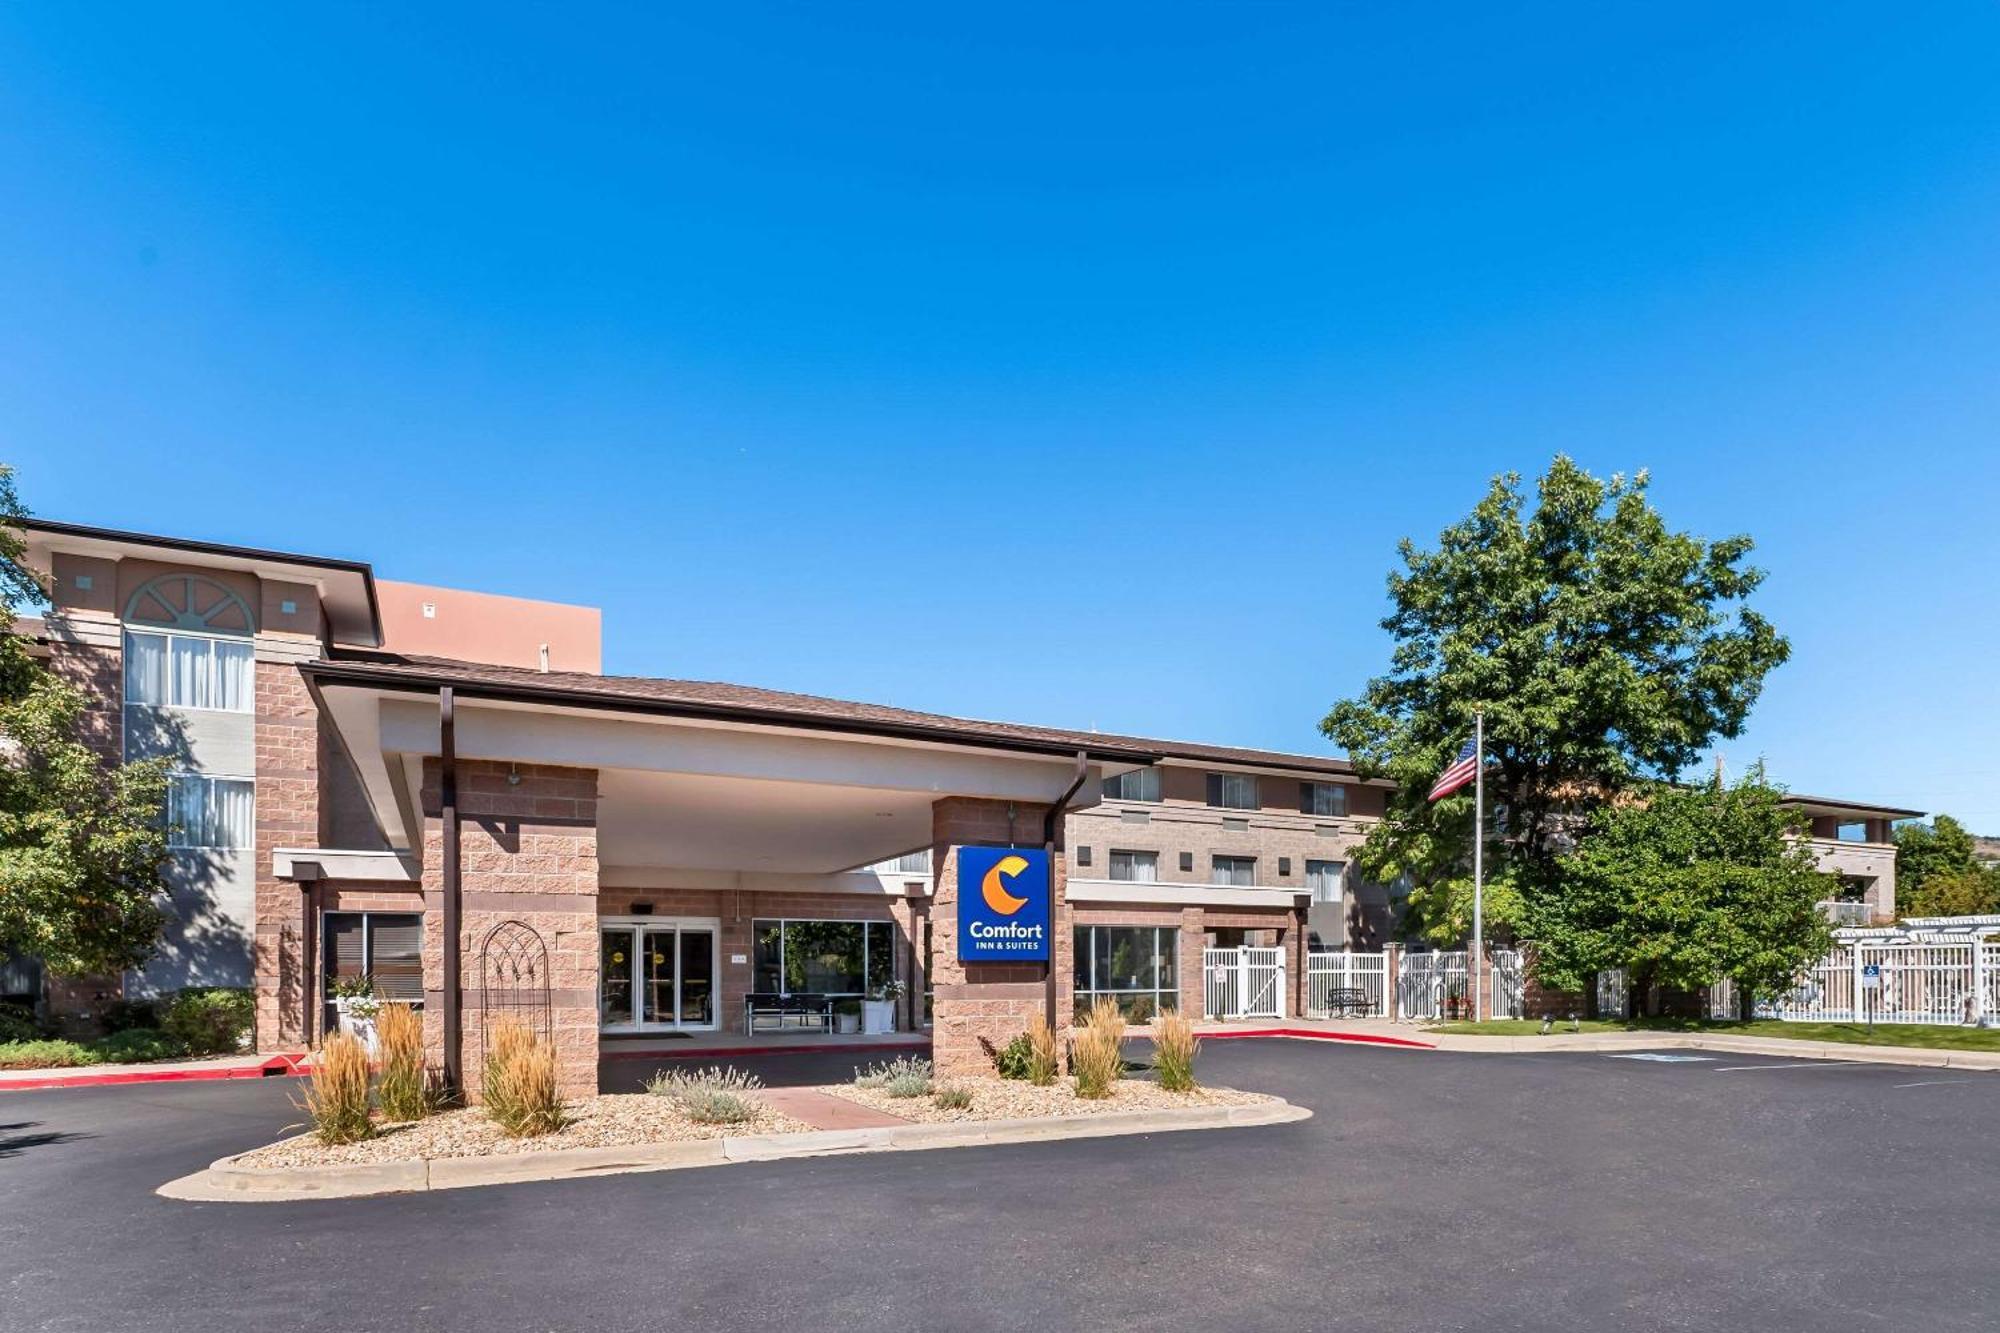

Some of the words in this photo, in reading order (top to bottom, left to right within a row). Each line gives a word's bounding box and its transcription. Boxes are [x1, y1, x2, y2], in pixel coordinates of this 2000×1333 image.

[970, 921, 1042, 938] Comfort
[976, 942, 994, 950] INN
[997, 942, 1003, 950] &
[1006, 942, 1038, 950] SUITES
